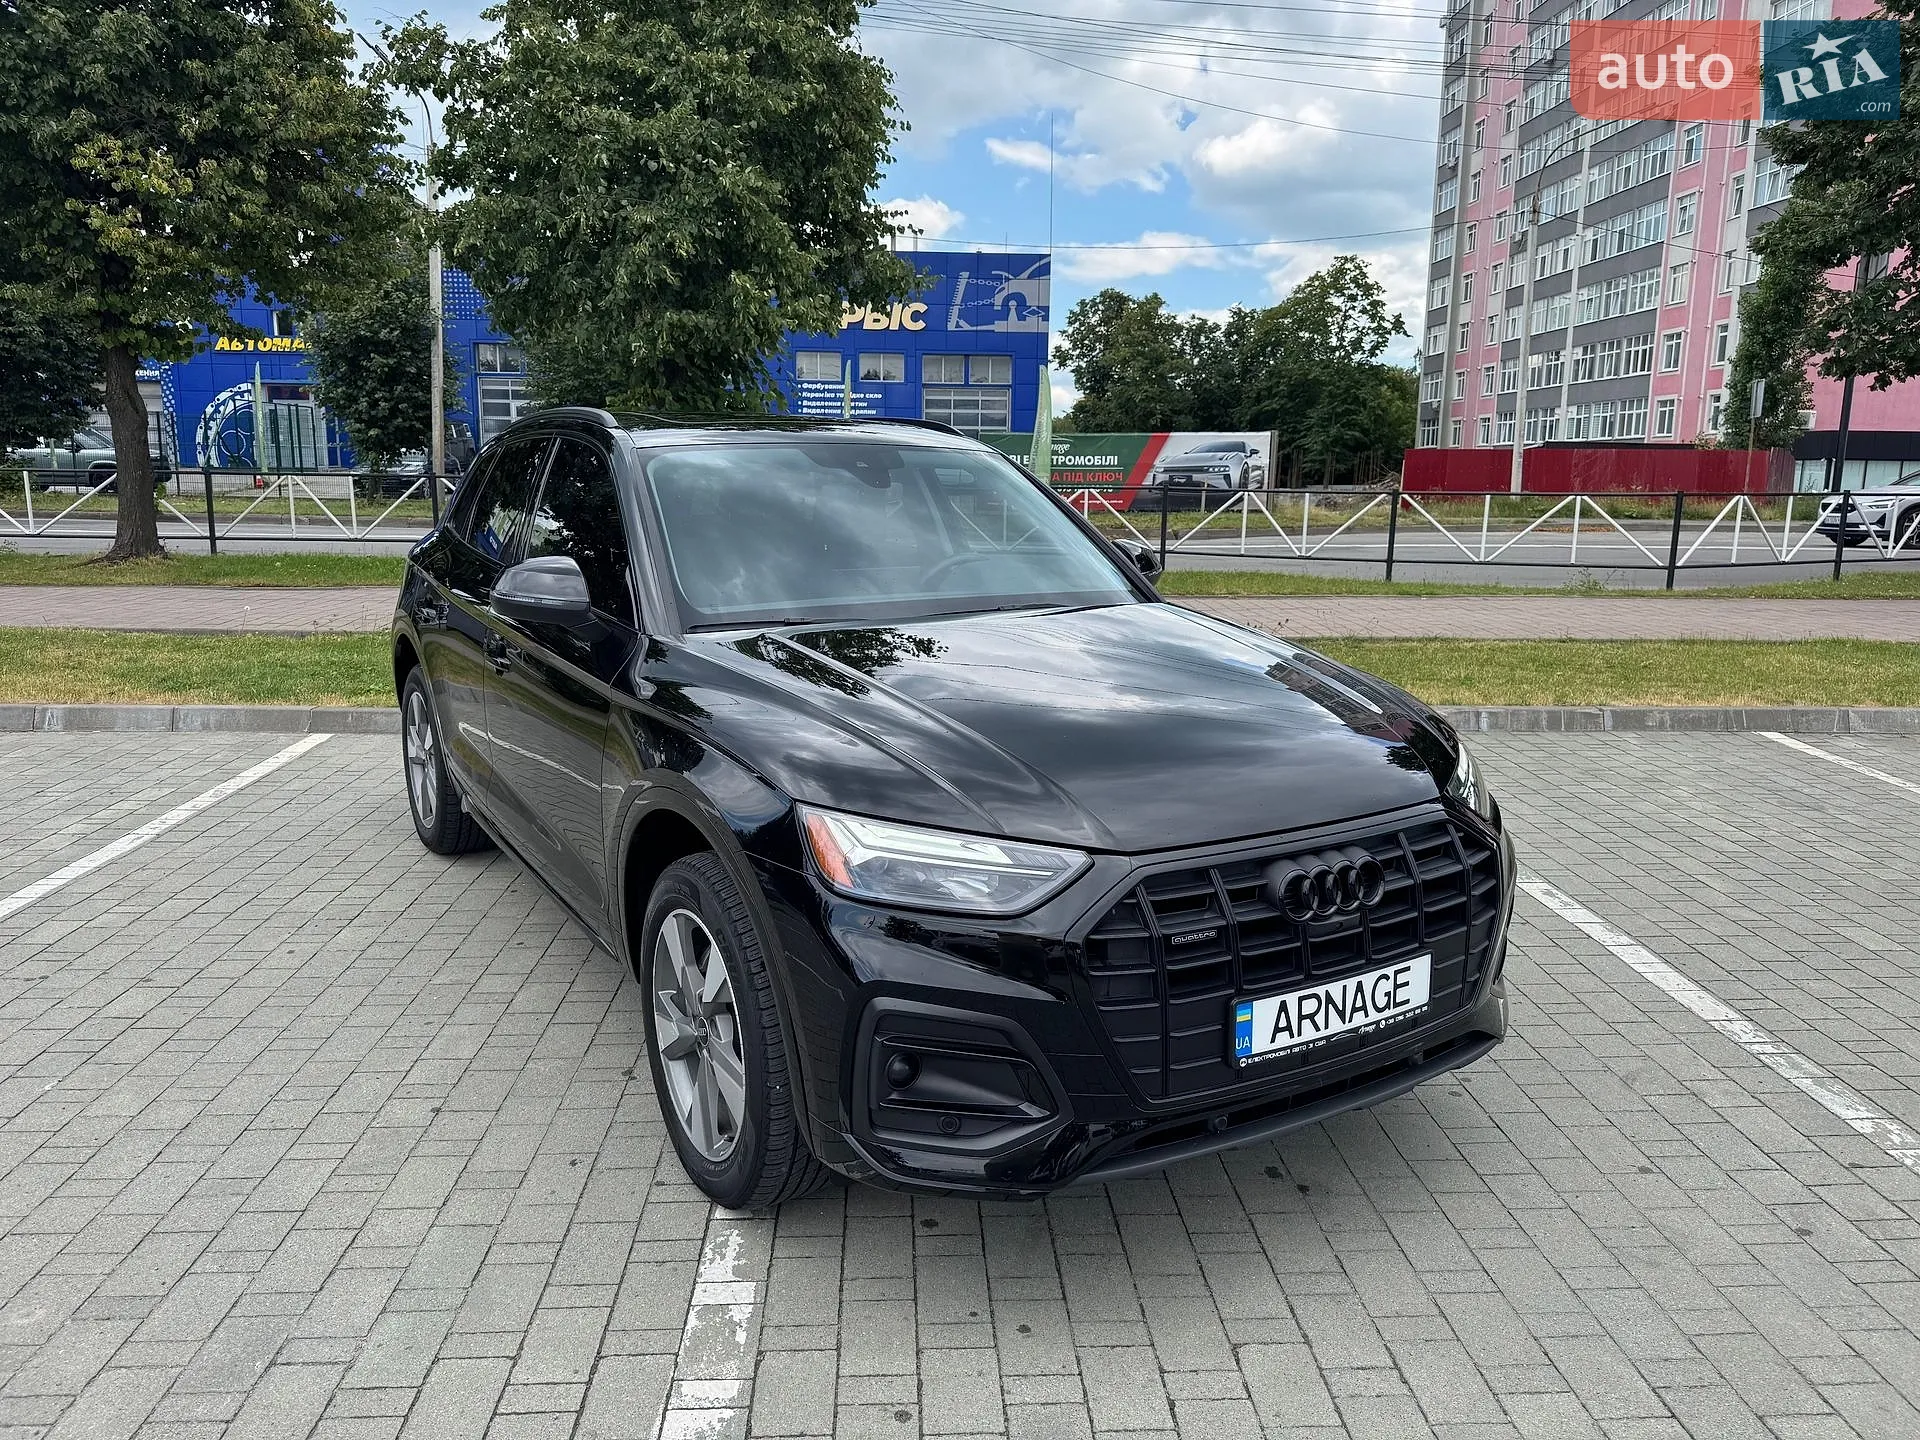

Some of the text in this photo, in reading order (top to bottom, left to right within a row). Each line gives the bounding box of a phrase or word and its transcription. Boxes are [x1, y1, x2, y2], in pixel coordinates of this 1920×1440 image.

[215, 336, 312, 352] АВТОМА
[1063, 471, 1084, 482] ПІД
[1087, 471, 1123, 481] КЛЮЧ
[1173, 930, 1217, 943] quattro
[1270, 965, 1412, 1044] ARNAGE
[1236, 1036, 1251, 1049] UA
